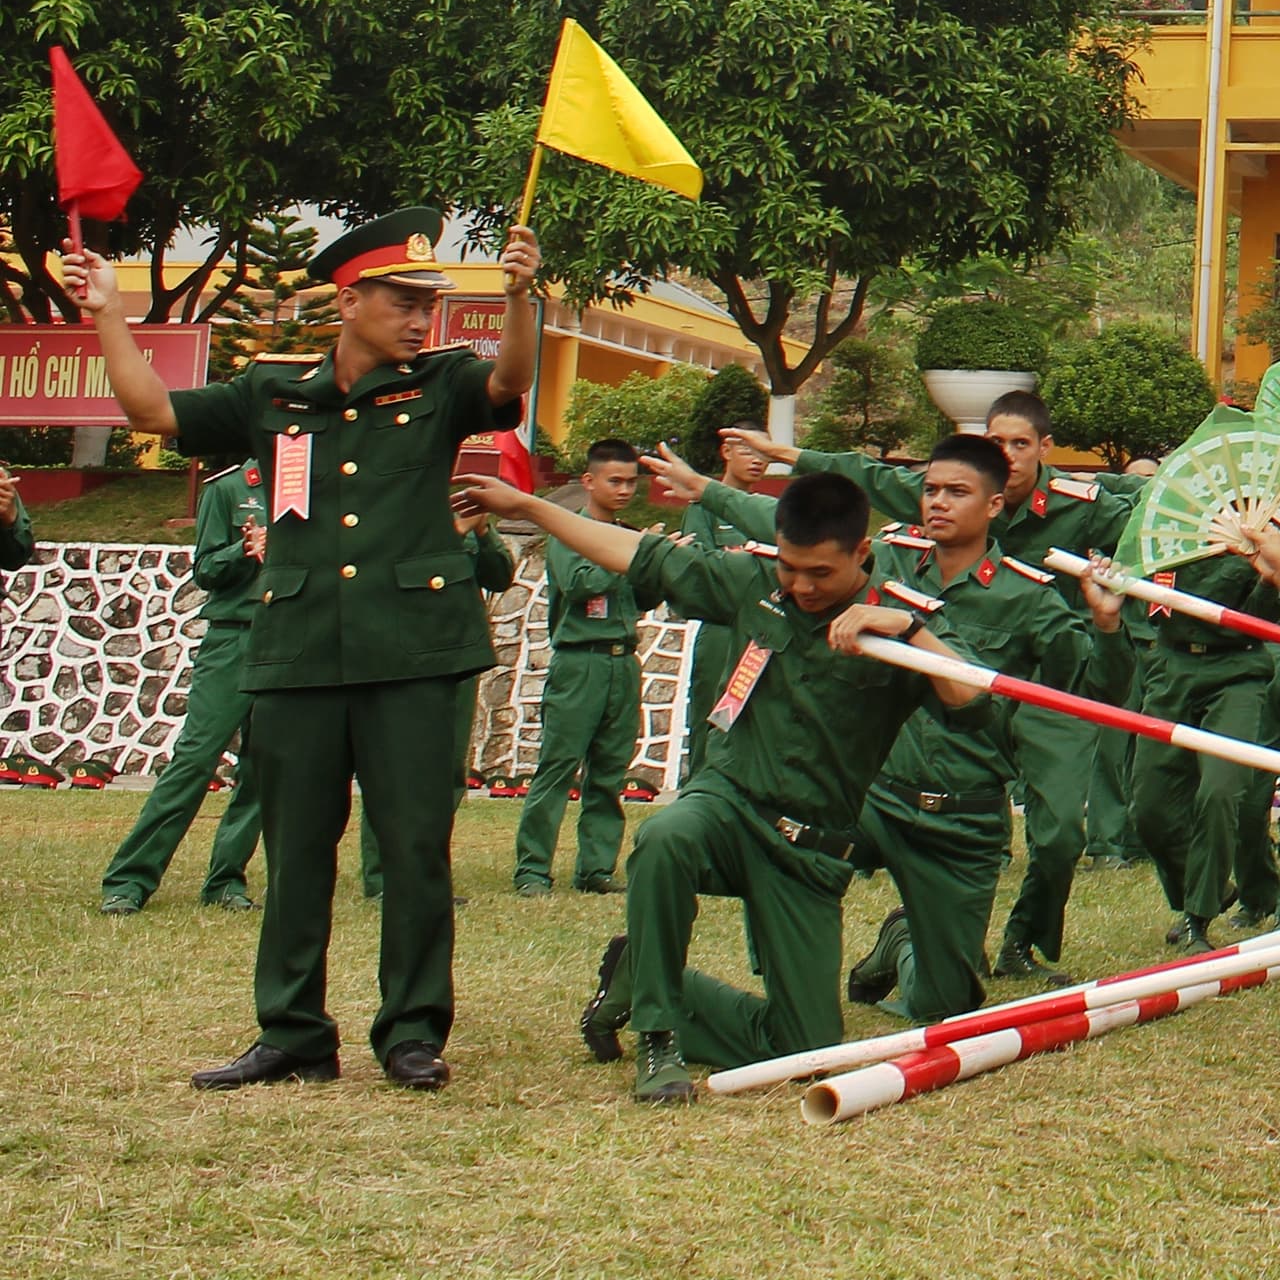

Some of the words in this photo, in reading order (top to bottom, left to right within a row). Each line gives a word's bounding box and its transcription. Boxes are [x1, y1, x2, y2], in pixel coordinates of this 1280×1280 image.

[462, 310, 486, 329] XÂY
[488, 314, 504, 334] DỰ
[9, 341, 40, 398] HỒ
[44, 346, 82, 398] CHÍ
